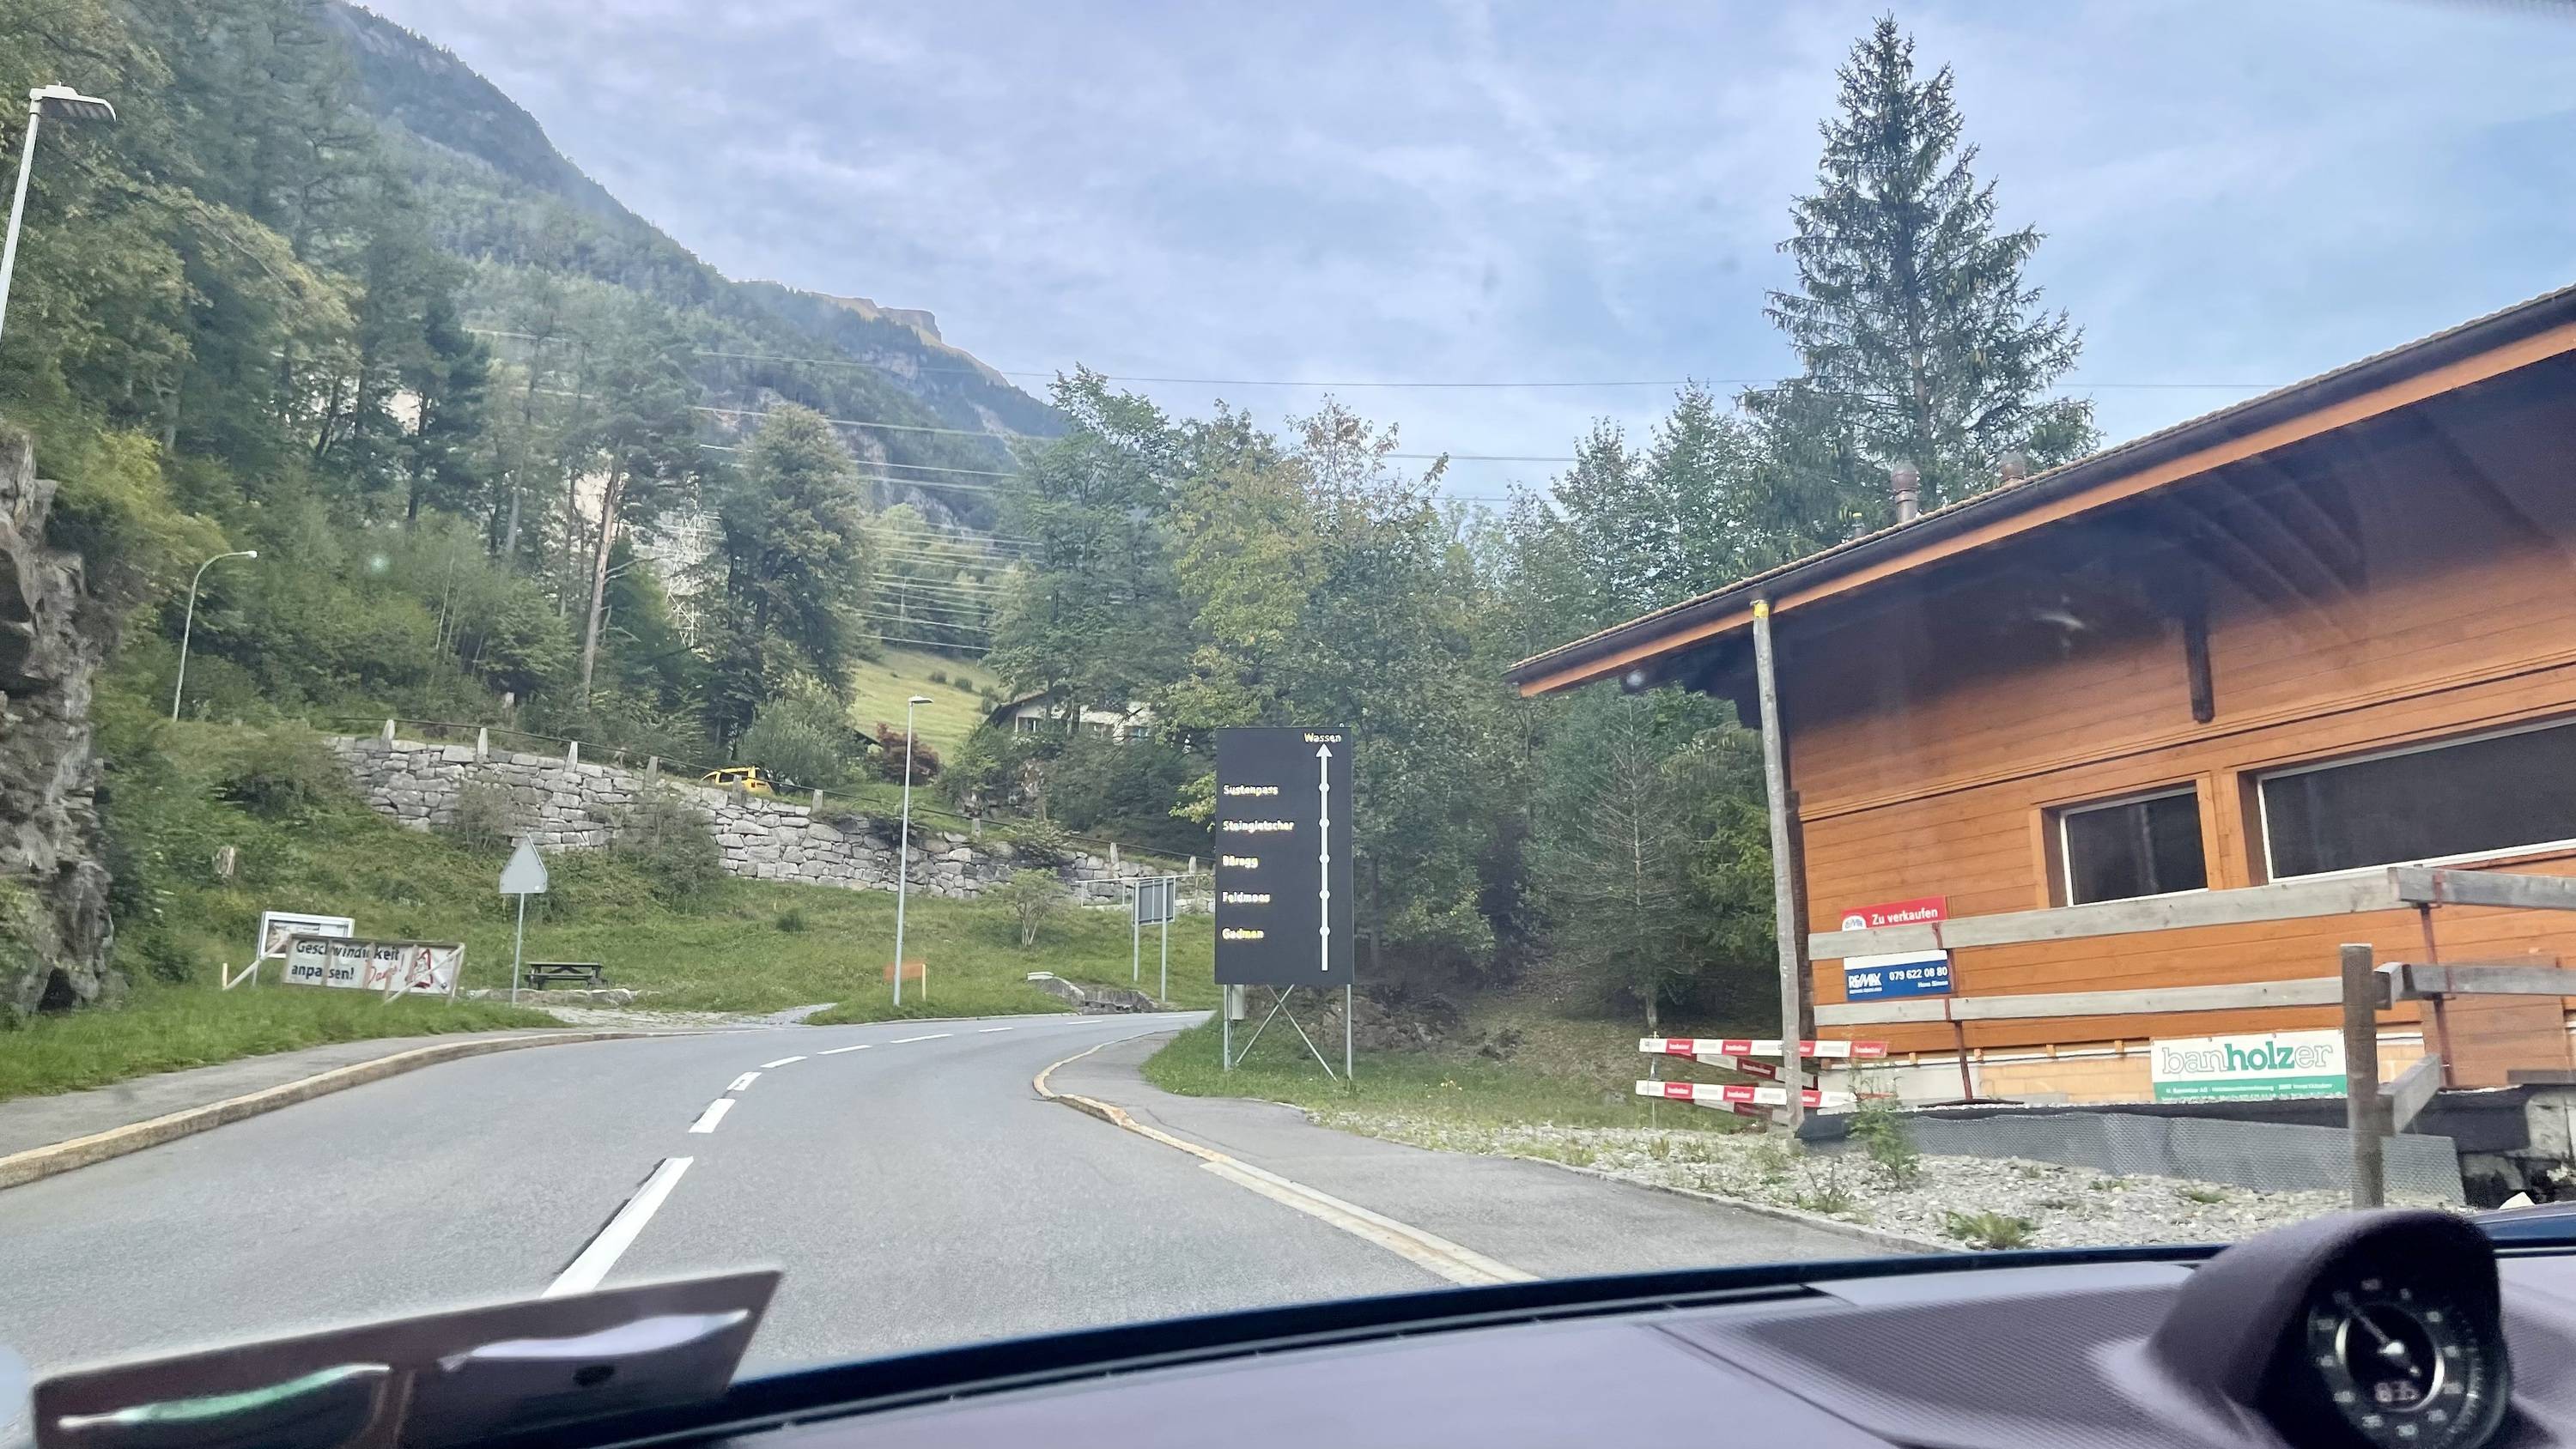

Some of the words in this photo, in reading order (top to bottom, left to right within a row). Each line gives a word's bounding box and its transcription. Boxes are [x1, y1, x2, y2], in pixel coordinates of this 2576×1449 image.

[1304, 733, 1342, 743] Wassen
[1223, 785, 1279, 797] Sustenpass
[1223, 820, 1295, 834] Steingletscher
[1222, 891, 1271, 903] Feldmoos
[1872, 913, 1886, 925] Zu
[1887, 907, 1938, 923] verkaufen
[1222, 928, 1265, 940] Gadmen
[291, 964, 355, 980] anpasen!
[1889, 971, 1905, 981] 079
[1906, 968, 1923, 979] 622
[1923, 967, 1935, 978] 08
[1936, 966, 1948, 977] 80
[2161, 1040, 2334, 1074] banholzer
